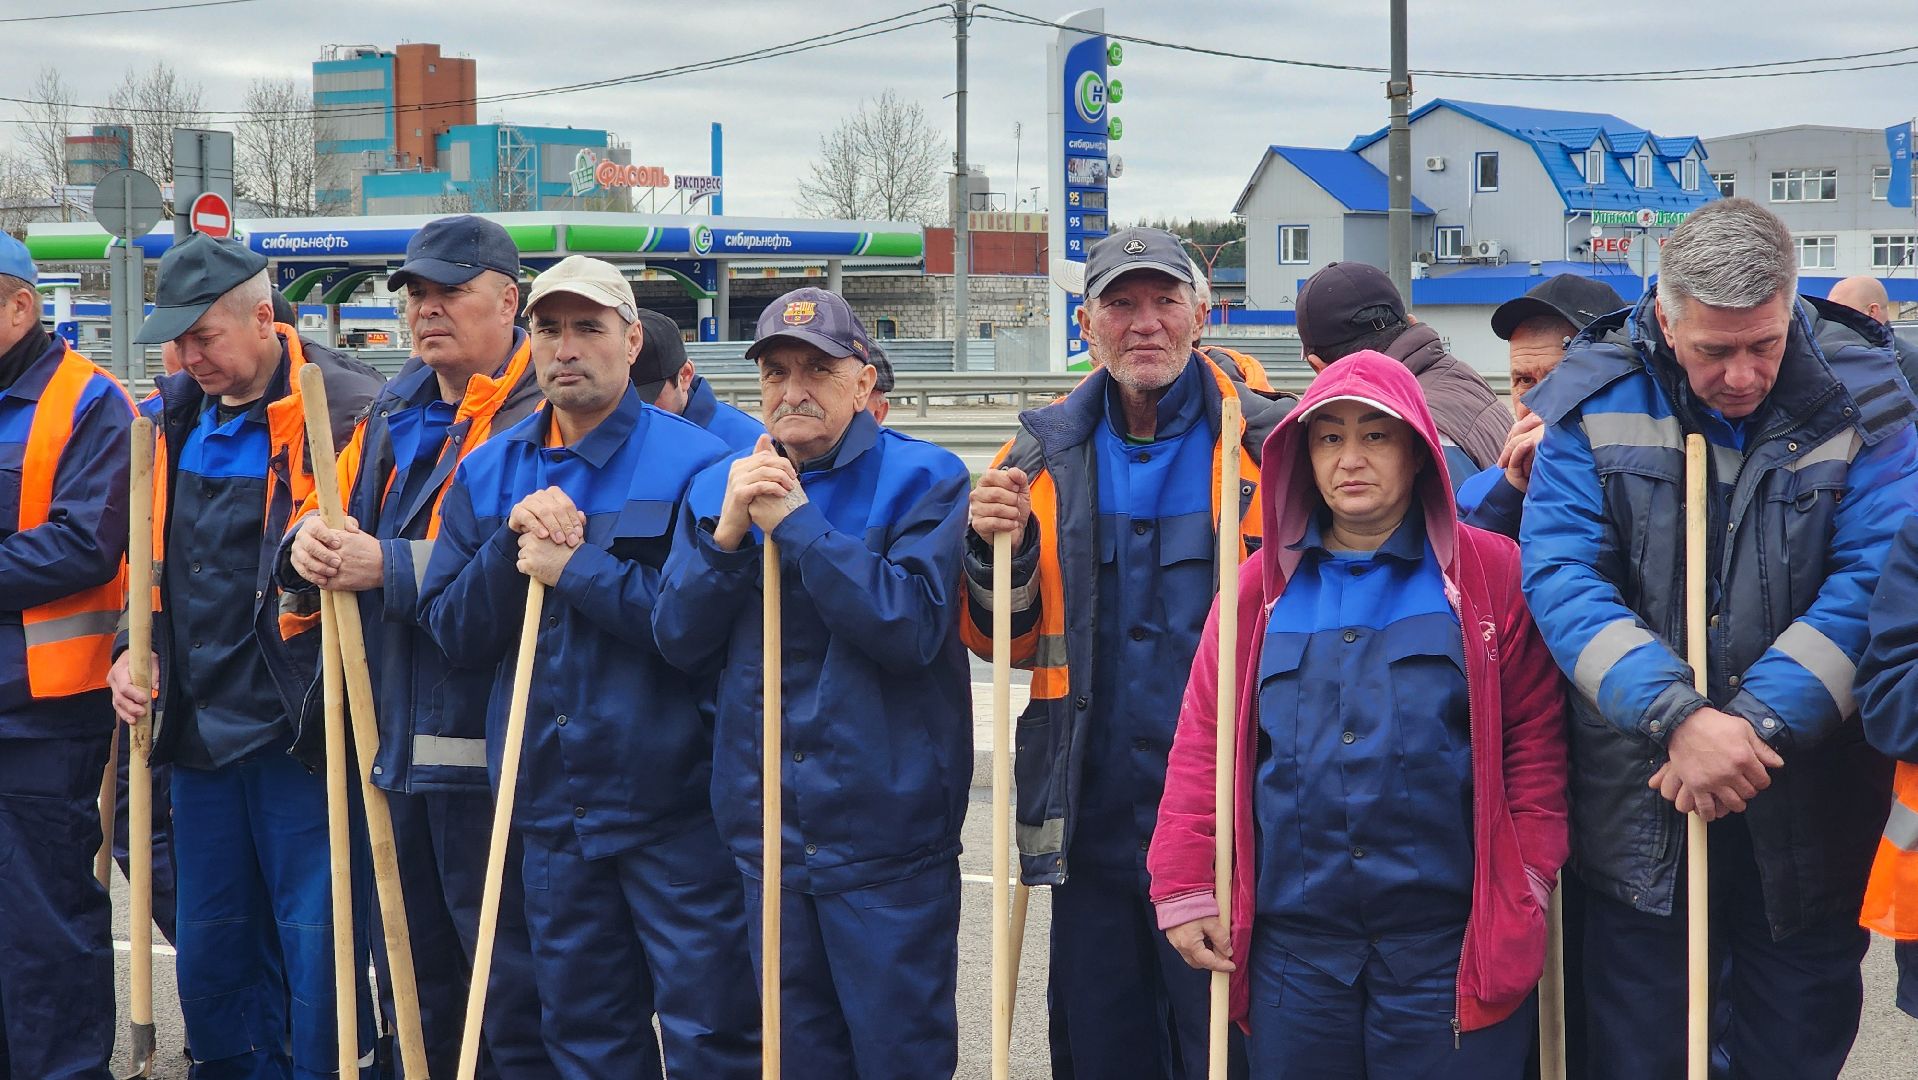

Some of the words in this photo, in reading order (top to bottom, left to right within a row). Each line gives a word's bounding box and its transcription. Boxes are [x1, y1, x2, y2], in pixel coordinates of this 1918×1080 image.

[596, 159, 670, 189] ФАСОЛЬ
[1069, 216, 1080, 228] 95
[262, 233, 349, 251] сибирьнефть
[724, 232, 792, 250] сибирьнефть
[1069, 239, 1080, 250] 92
[282, 268, 296, 280] 10
[693, 262, 701, 274] 2
